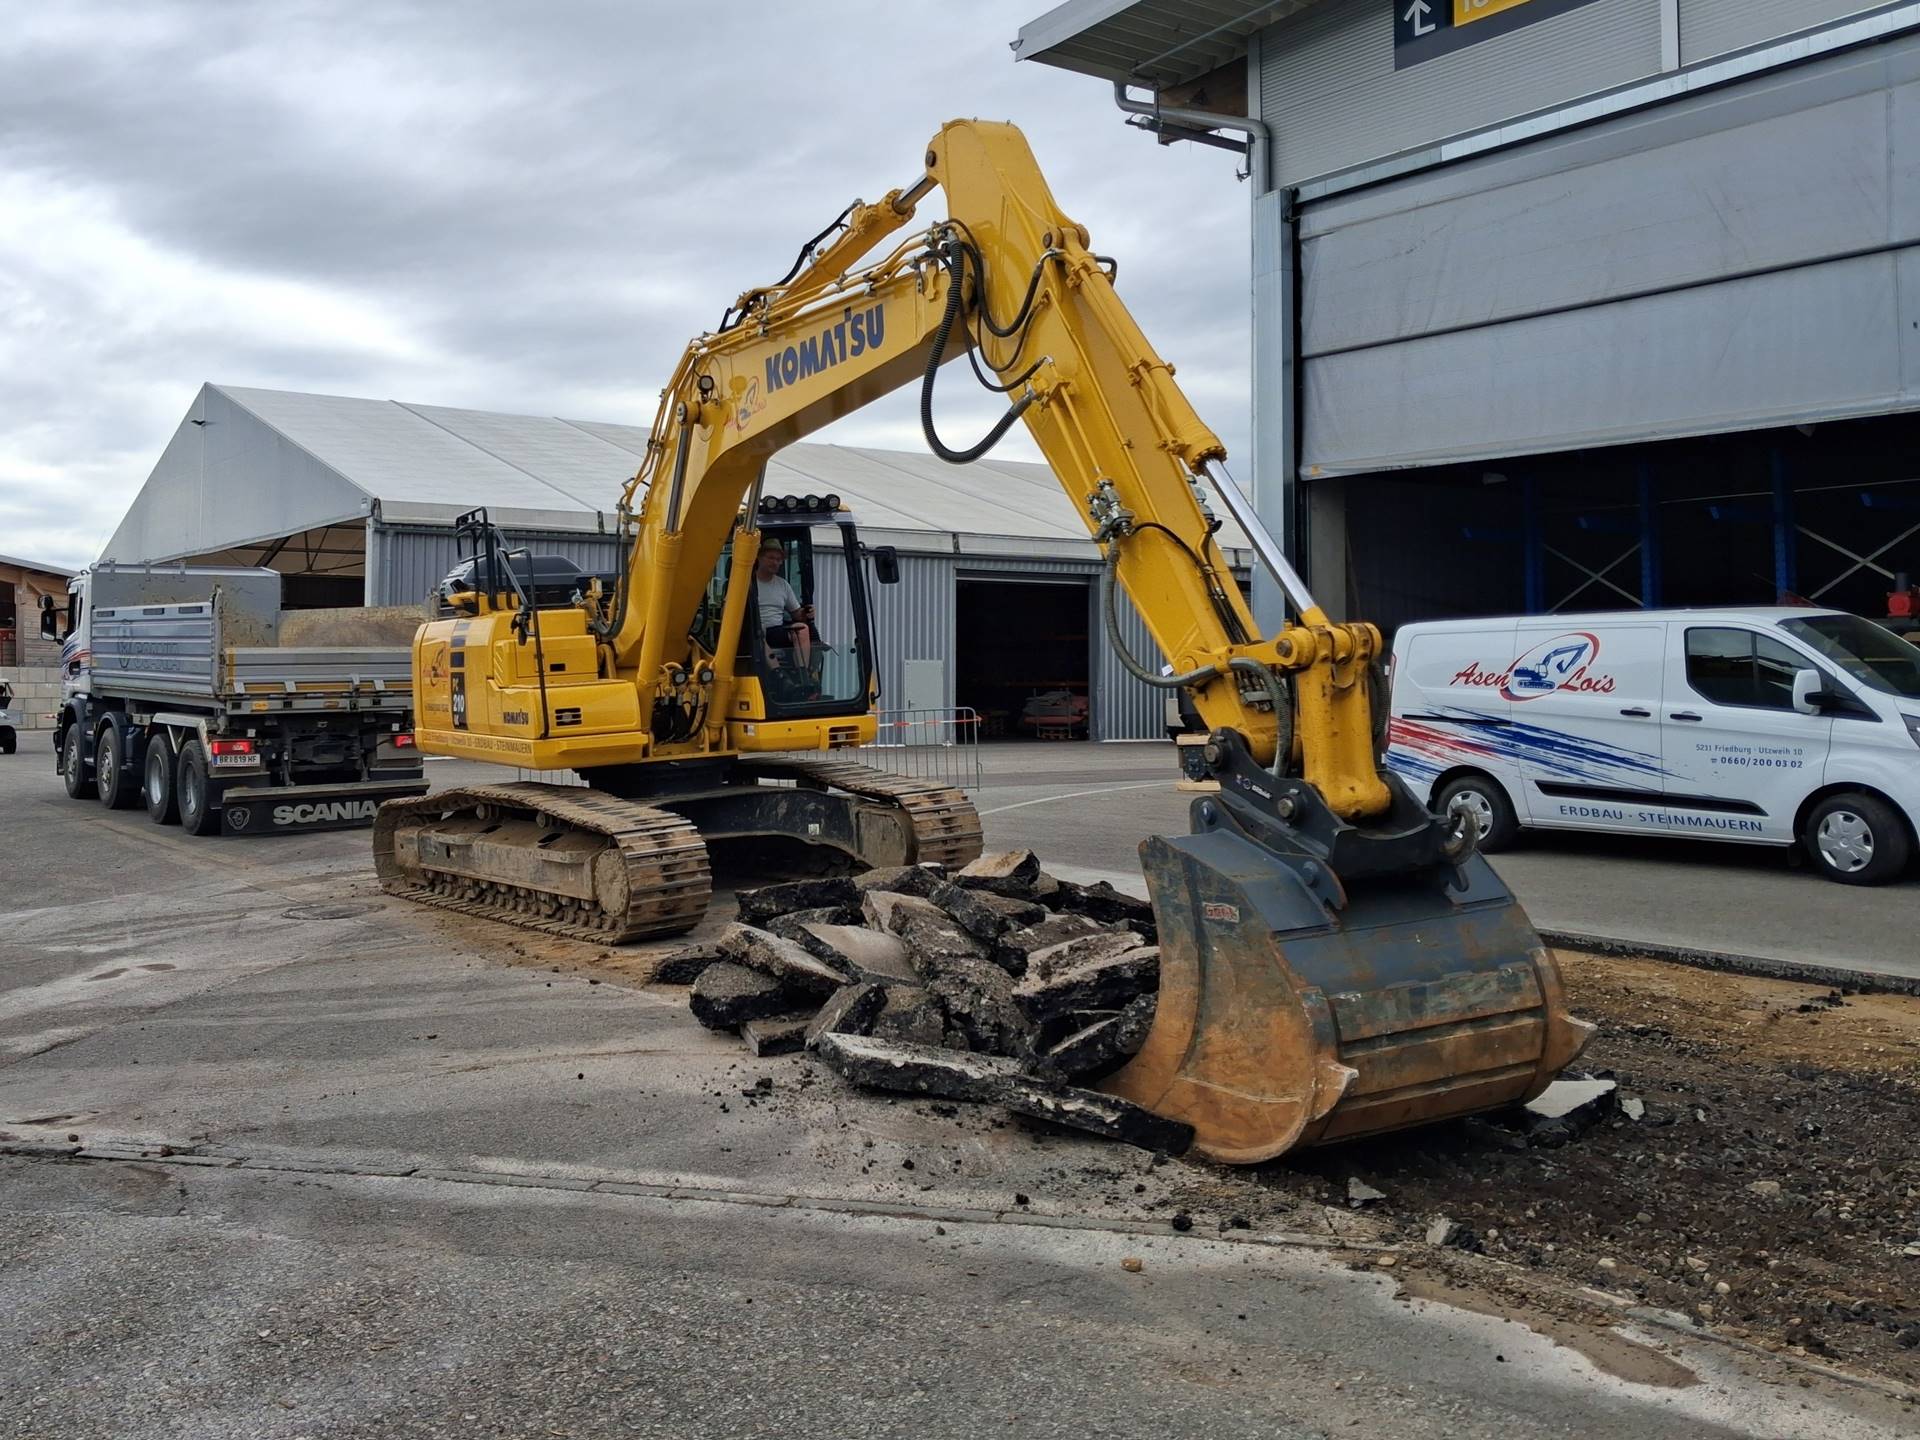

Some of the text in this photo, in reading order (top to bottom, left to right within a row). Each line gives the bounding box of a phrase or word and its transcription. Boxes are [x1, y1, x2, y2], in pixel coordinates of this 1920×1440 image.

[765, 303, 886, 394] KOMATSU
[1450, 661, 1617, 693] Asen Lois
[453, 694, 465, 713] 210
[503, 708, 529, 725] KOMATSU
[1714, 744, 1752, 755] Friedburg
[273, 799, 377, 825] SCANIA
[1559, 804, 1623, 820] ERDBAU
[1637, 811, 1763, 832] STEINMAUERN
